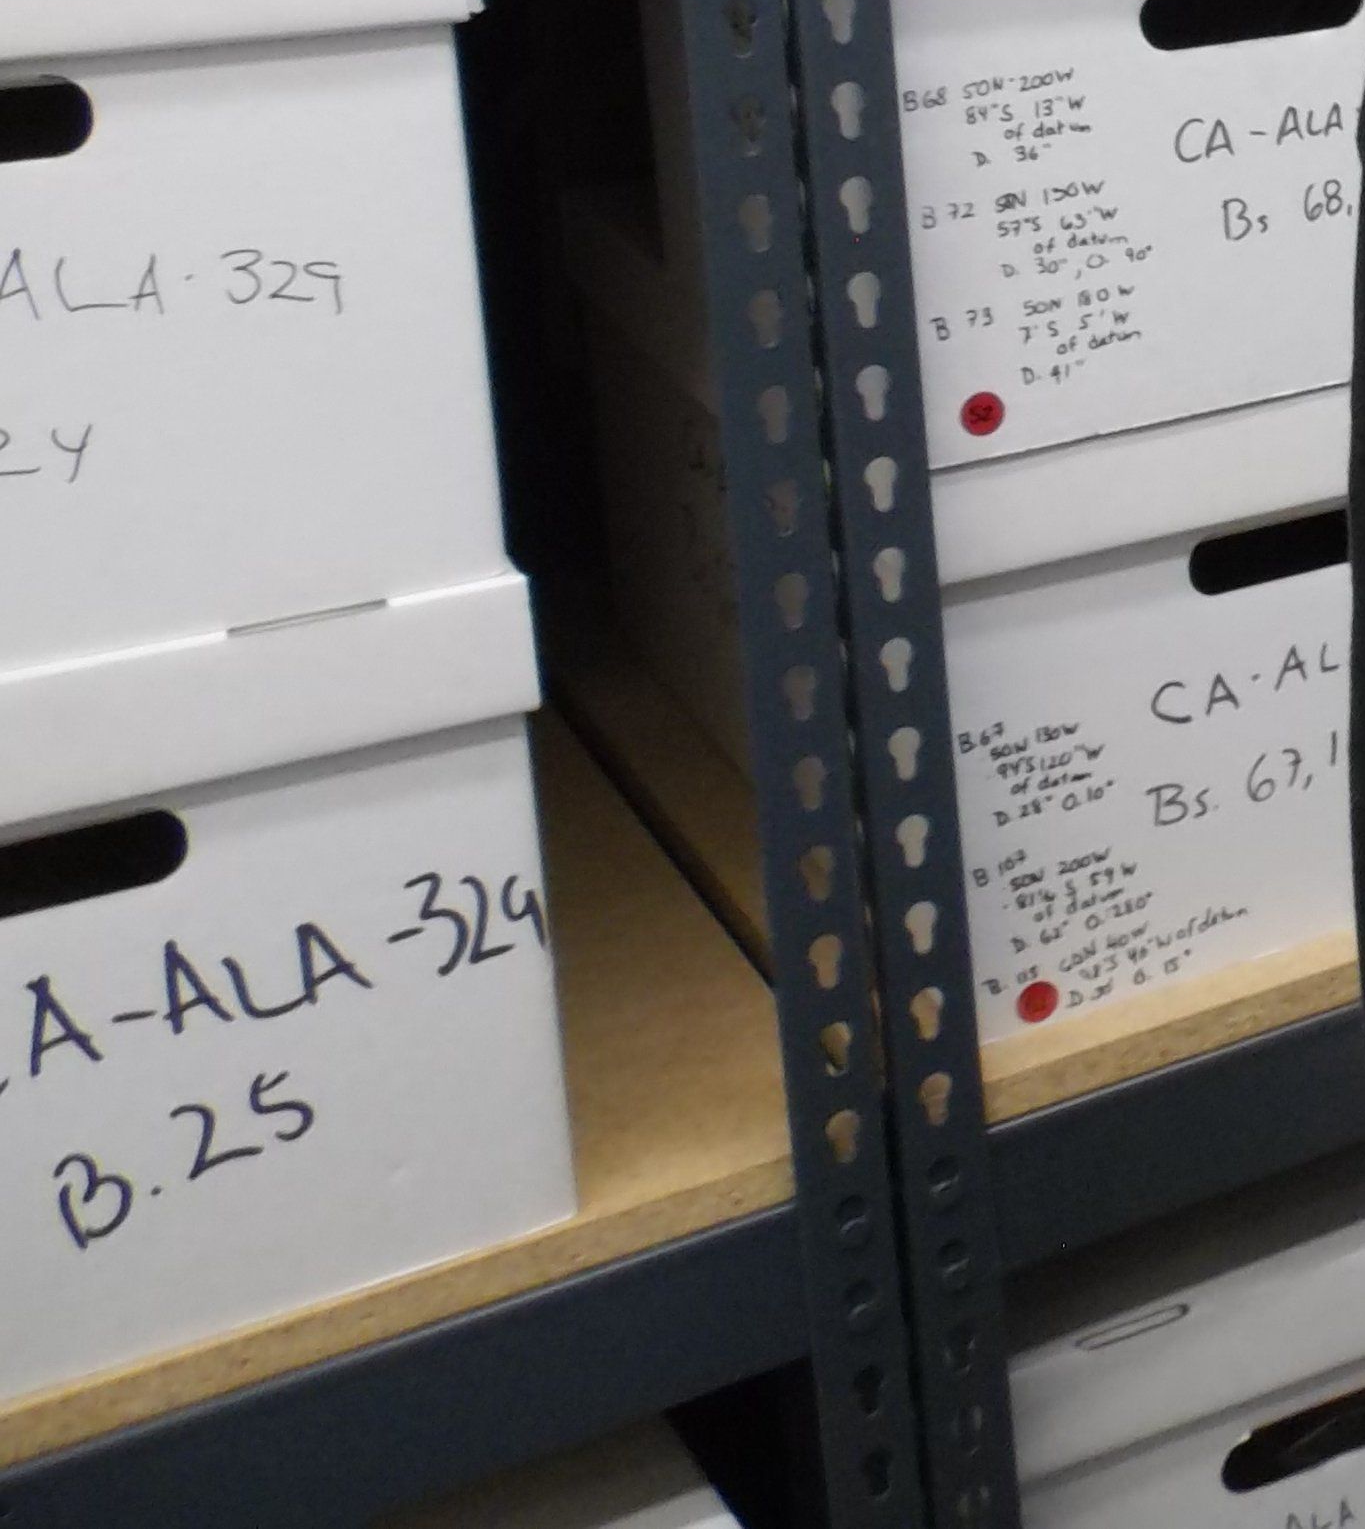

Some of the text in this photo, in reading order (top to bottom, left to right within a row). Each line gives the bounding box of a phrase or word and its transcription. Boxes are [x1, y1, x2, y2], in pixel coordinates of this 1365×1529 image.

[1004, 124, 1025, 140] of
[1033, 237, 1057, 255] of
[1057, 337, 1079, 355] of
[0, 872, 548, 1106] A-ALA-329
